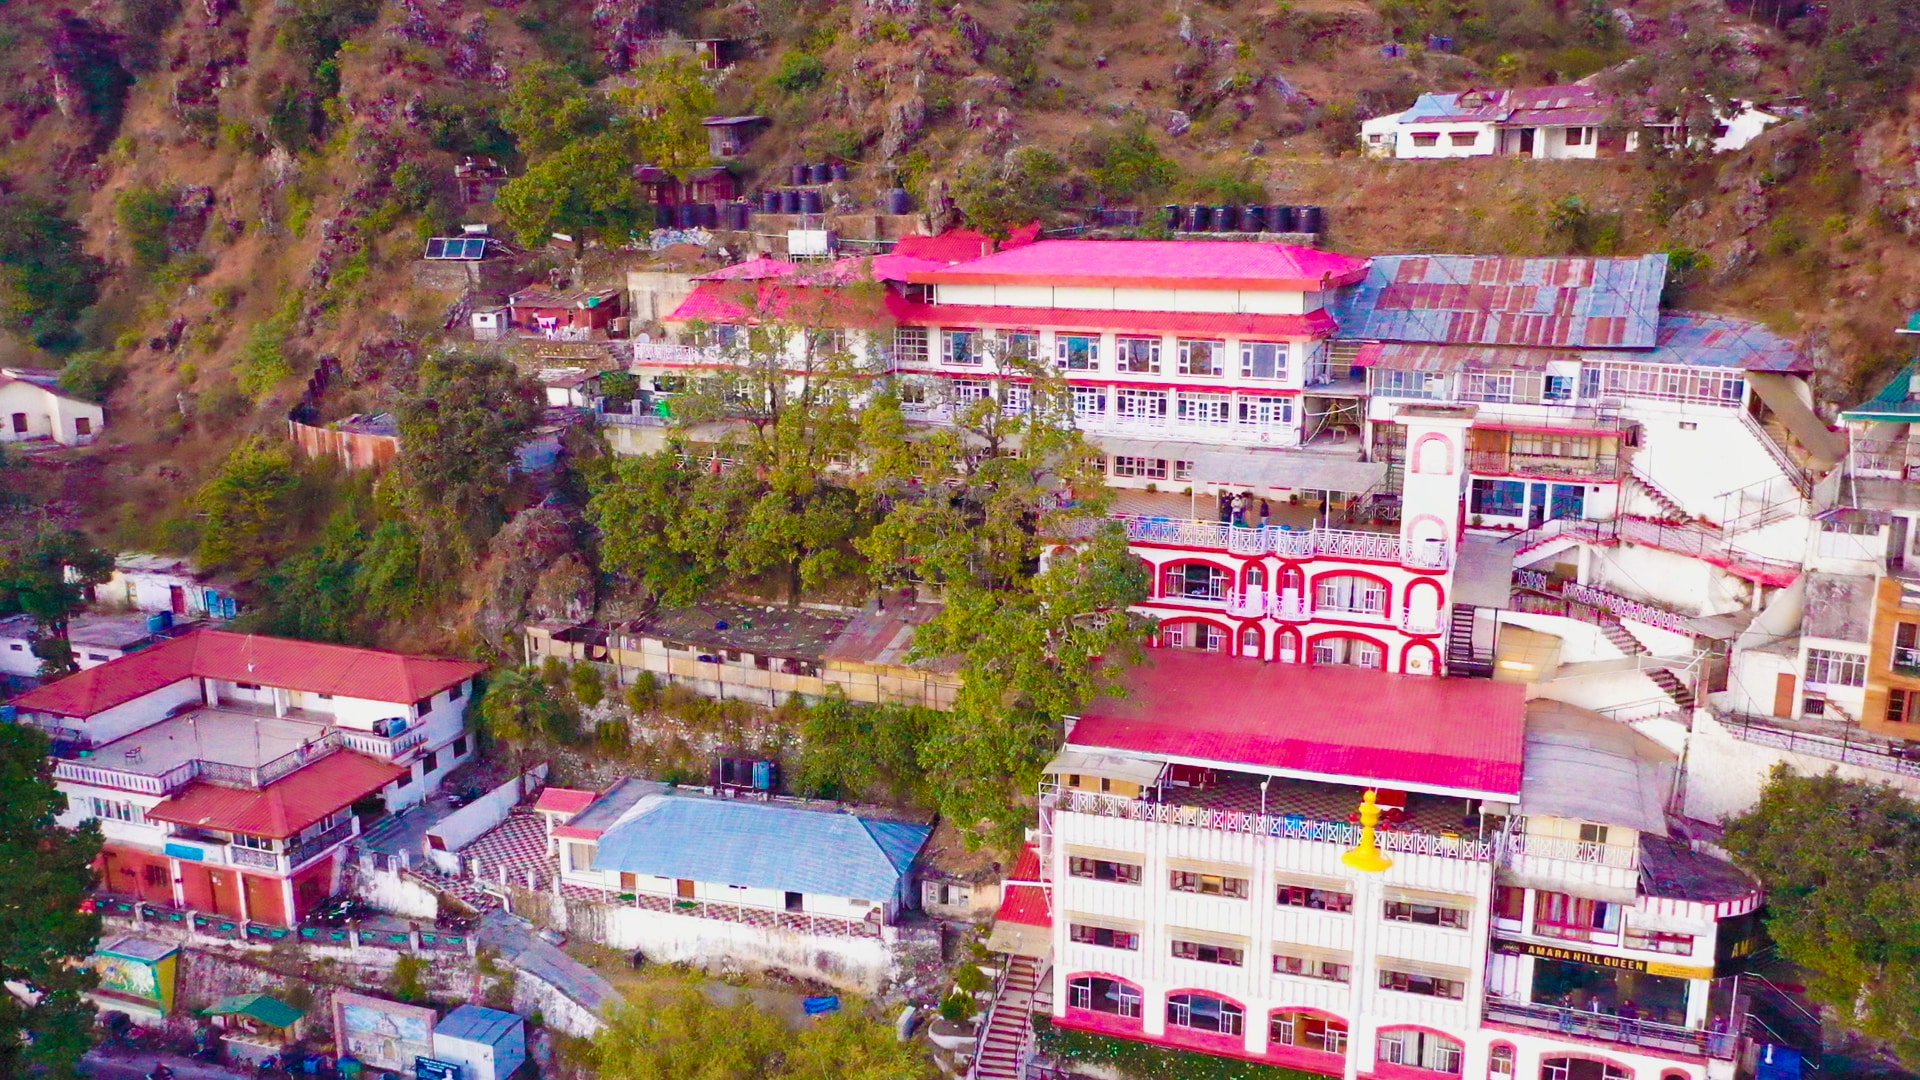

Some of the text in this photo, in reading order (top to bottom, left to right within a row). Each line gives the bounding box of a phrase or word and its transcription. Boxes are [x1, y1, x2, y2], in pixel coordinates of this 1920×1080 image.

[1528, 945, 1570, 959] AMARA
[1573, 952, 1600, 965] HILL
[1603, 957, 1643, 971] QUEEN
